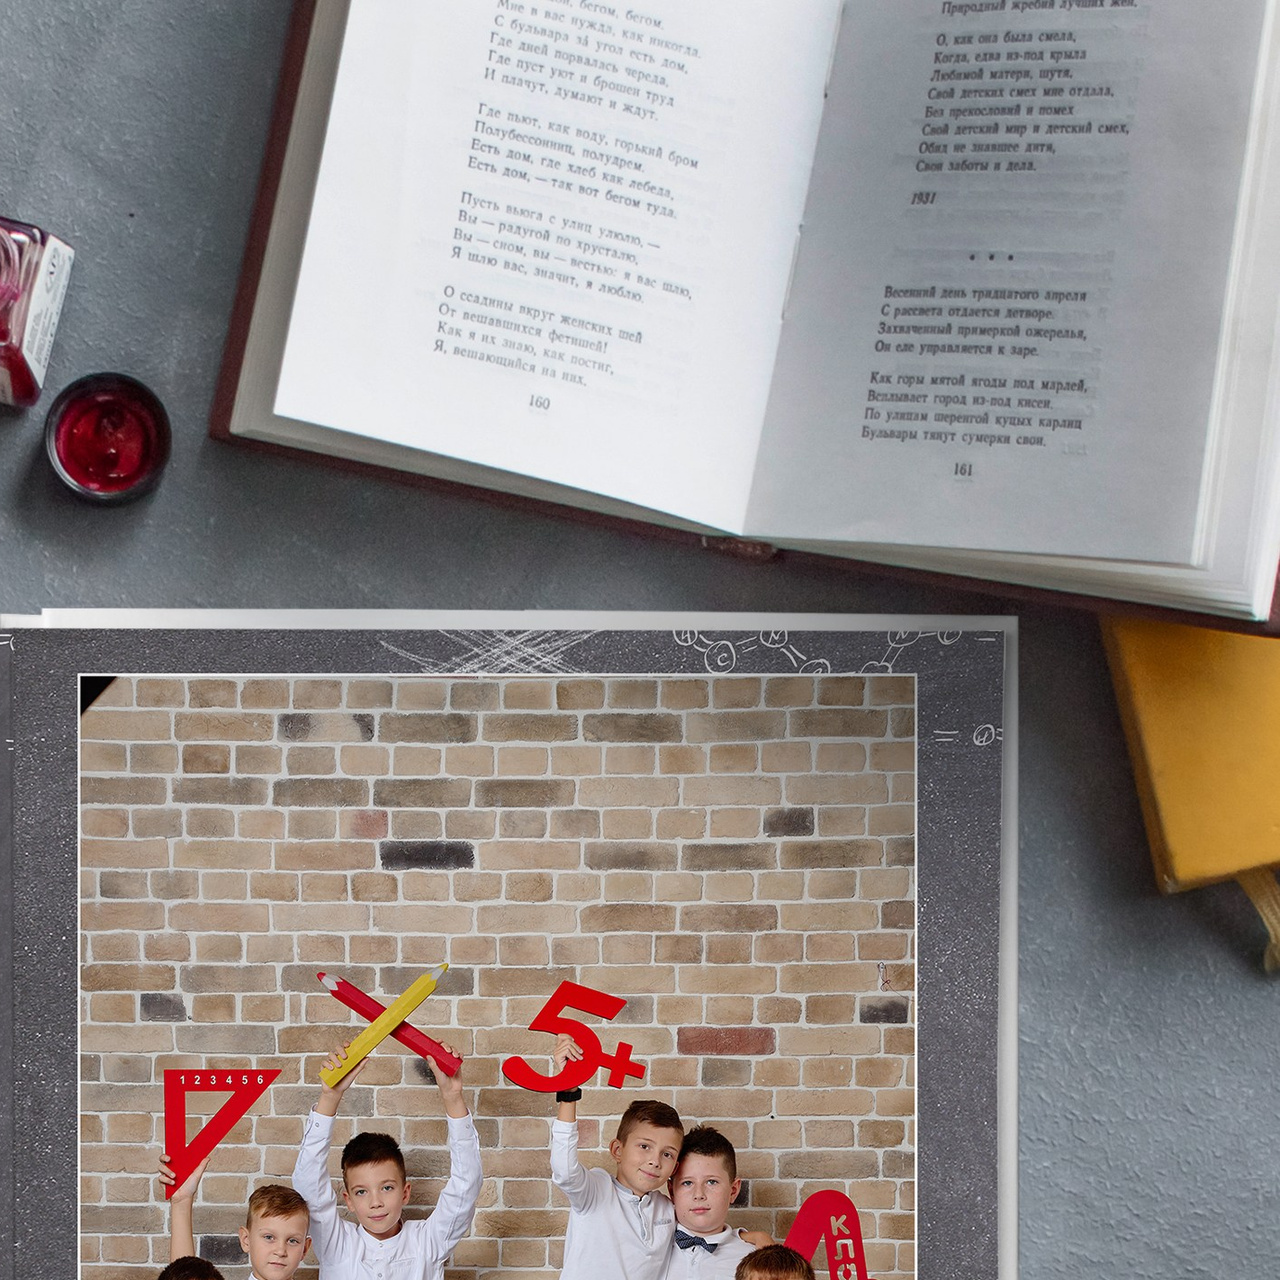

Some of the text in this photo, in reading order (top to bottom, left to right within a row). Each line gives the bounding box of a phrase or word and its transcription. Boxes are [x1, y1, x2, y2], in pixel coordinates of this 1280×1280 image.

[911, 191, 937, 205] 1931
[529, 394, 551, 410] 160
[954, 462, 972, 477] 161
[179, 1075, 264, 1085] 1 2 3 4 5 6
